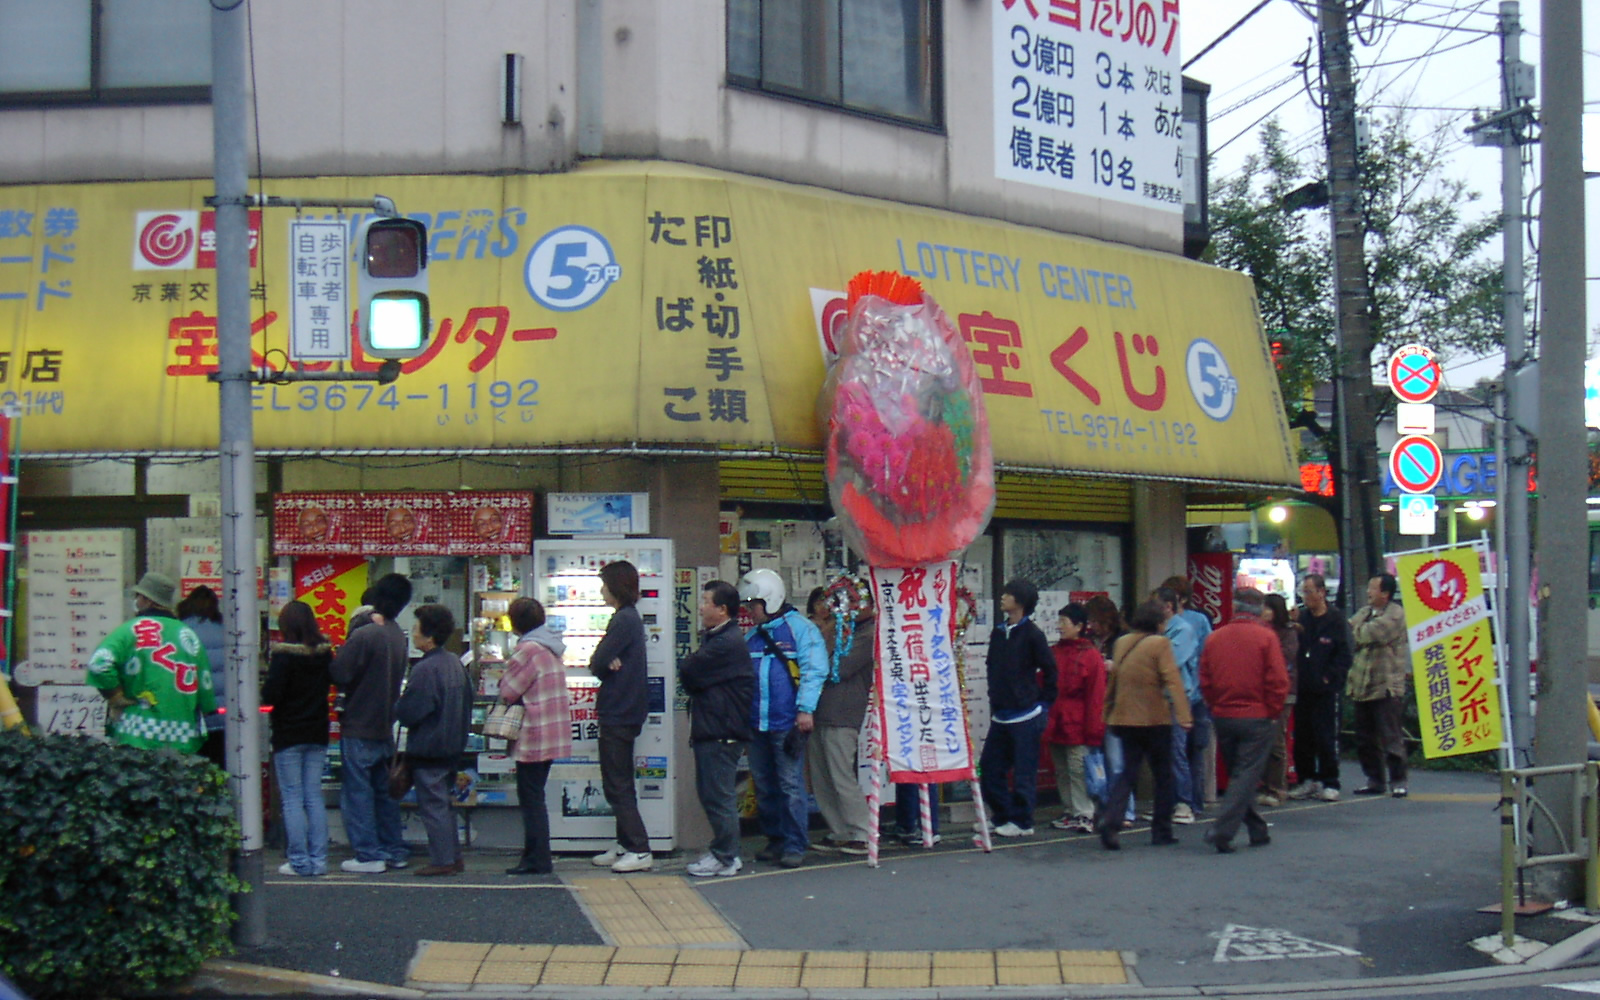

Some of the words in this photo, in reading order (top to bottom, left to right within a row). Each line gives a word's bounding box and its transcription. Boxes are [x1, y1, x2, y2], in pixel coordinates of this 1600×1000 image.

[1011, 24, 1075, 79] 3億円
[1096, 51, 1135, 95] 3本
[1144, 65, 1172, 96] 次は
[1011, 75, 1075, 128] 2億円
[1100, 101, 1135, 142] 1本
[1009, 125, 1075, 180] 億長者
[1091, 147, 1136, 191] 19名
[132, 281, 269, 303] 京葉交点
[296, 231, 319, 300] 自転車
[320, 231, 343, 302] 歩行者
[896, 238, 1022, 293] LOTTERY
[1038, 262, 1137, 310] CENTER
[309, 305, 331, 351] 専用
[647, 210, 702, 422] たばこ
[0, 348, 63, 383] 店
[957, 310, 1167, 411] 宝くじ
[250, 379, 540, 412] EL3674-1192
[436, 409, 535, 426] いいくじ
[301, 564, 336, 588] 本日は
[132, 618, 200, 694] 宝くじ
[1415, 604, 1483, 643] お急ぎください
[1423, 642, 1456, 751] 発売期限迫る
[1450, 626, 1490, 726] ジャンボ
